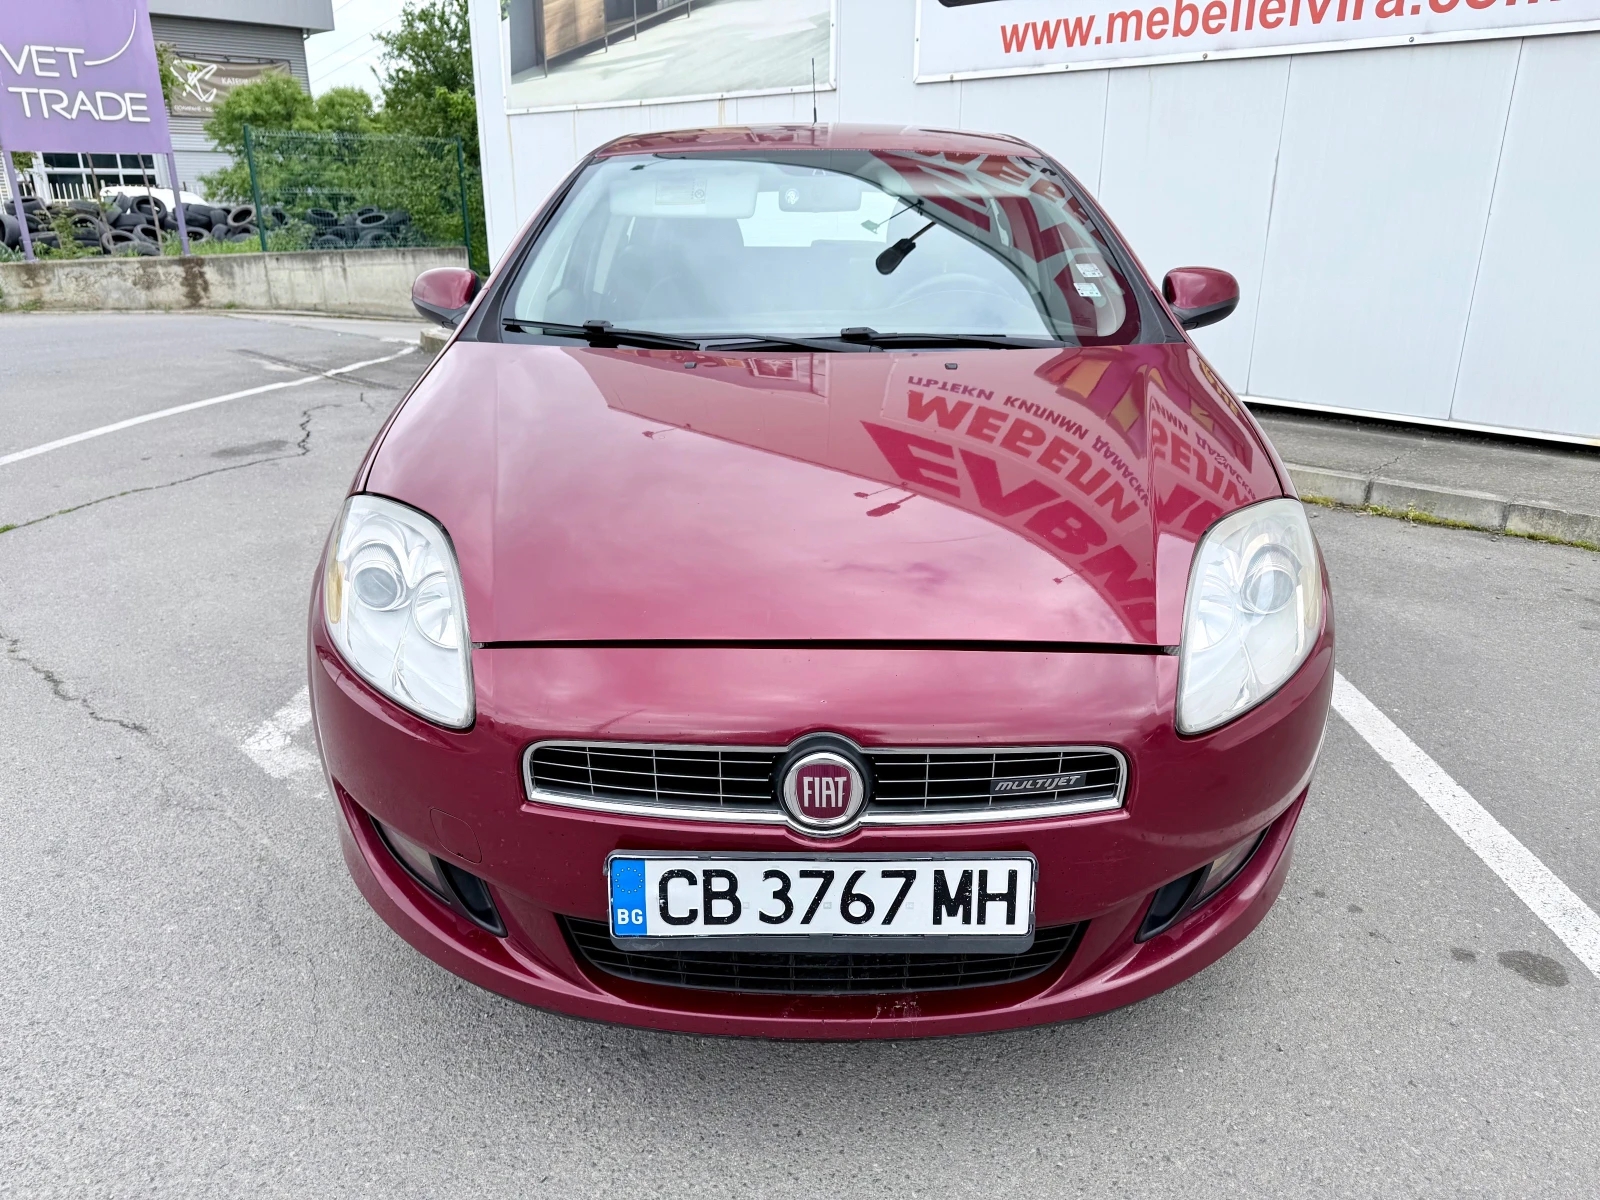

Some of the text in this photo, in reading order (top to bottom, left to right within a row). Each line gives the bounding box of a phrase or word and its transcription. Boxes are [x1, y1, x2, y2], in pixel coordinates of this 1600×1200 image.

[0, 44, 84, 78] VET
[8, 87, 150, 122] TRADE
[803, 776, 847, 808] FIAT
[995, 776, 1081, 791] MULTIJET
[659, 869, 1018, 925] CB 3767 MH
[617, 909, 643, 925] BG
